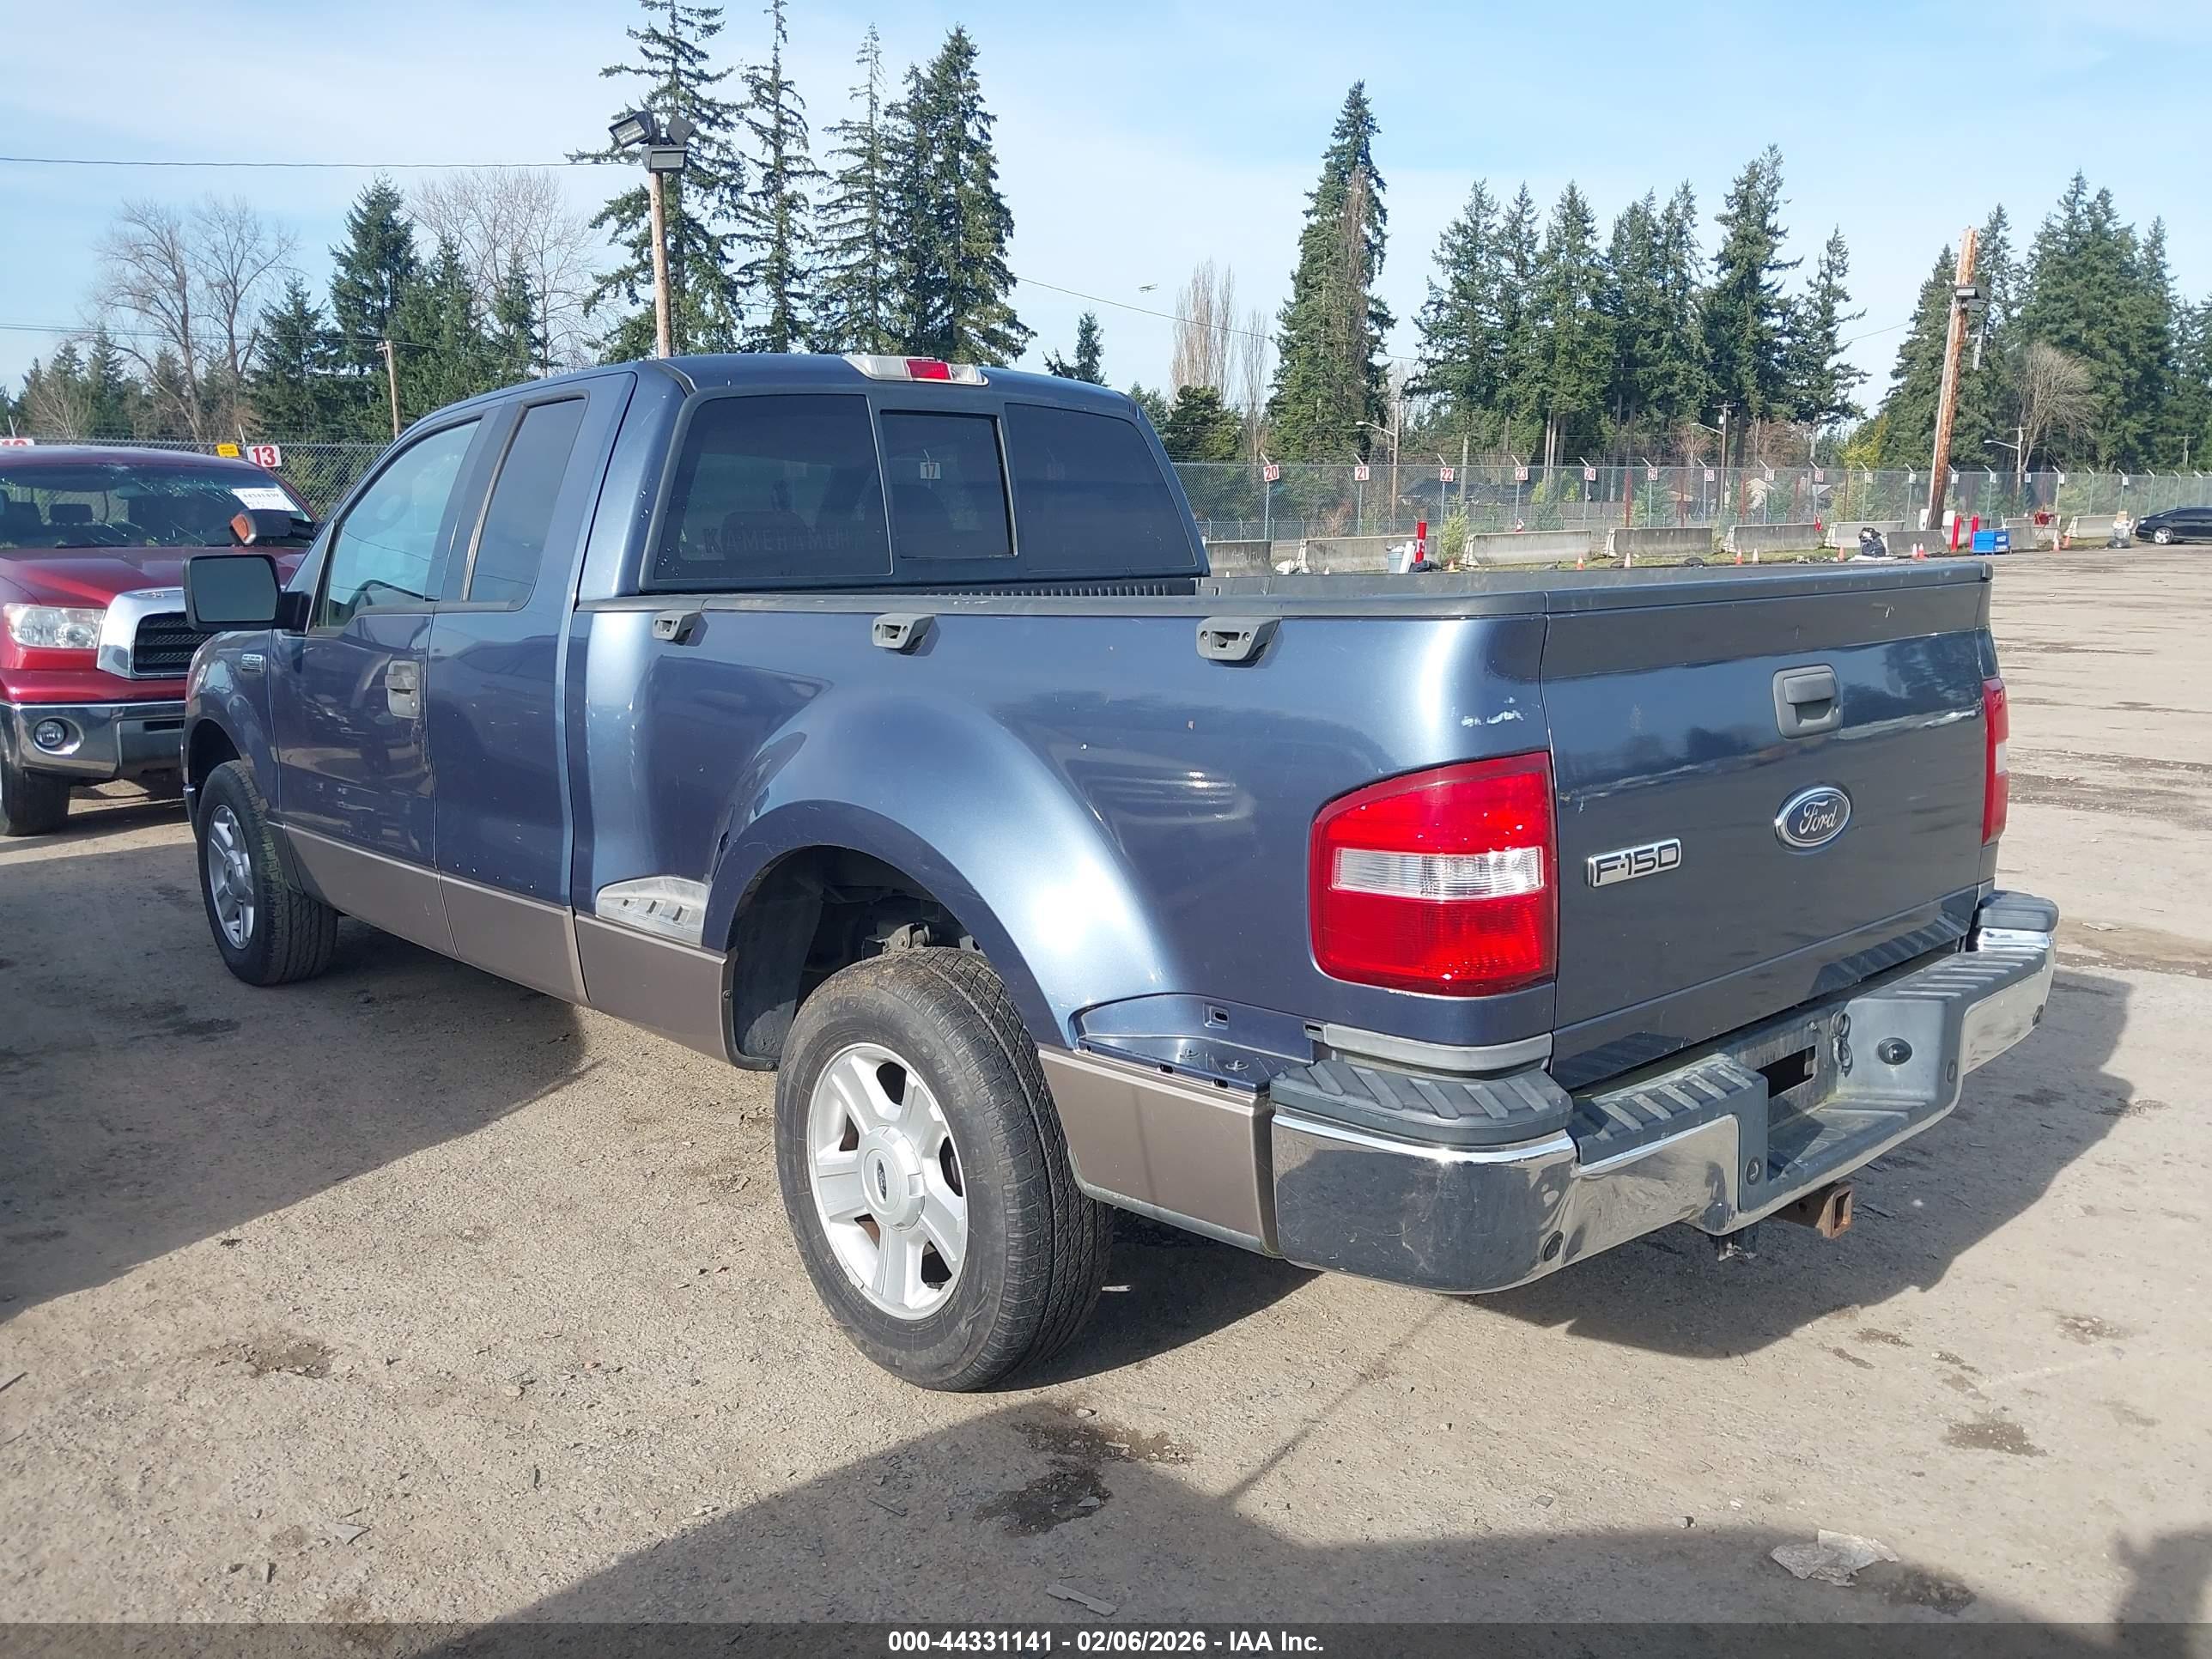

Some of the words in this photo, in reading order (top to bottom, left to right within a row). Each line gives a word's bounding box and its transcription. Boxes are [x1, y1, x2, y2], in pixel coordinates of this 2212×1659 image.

[252, 446, 276, 466] 13
[1265, 465, 1278, 480] 20
[1357, 467, 1367, 480] 21
[1441, 468, 1453, 481] 22
[1516, 468, 1527, 479] 23
[1585, 468, 1595, 480] 24
[1649, 469, 1657, 480] 25
[1705, 470, 1713, 481] 26
[1799, 799, 1838, 836] Ford
[1595, 842, 1680, 884] F-150
